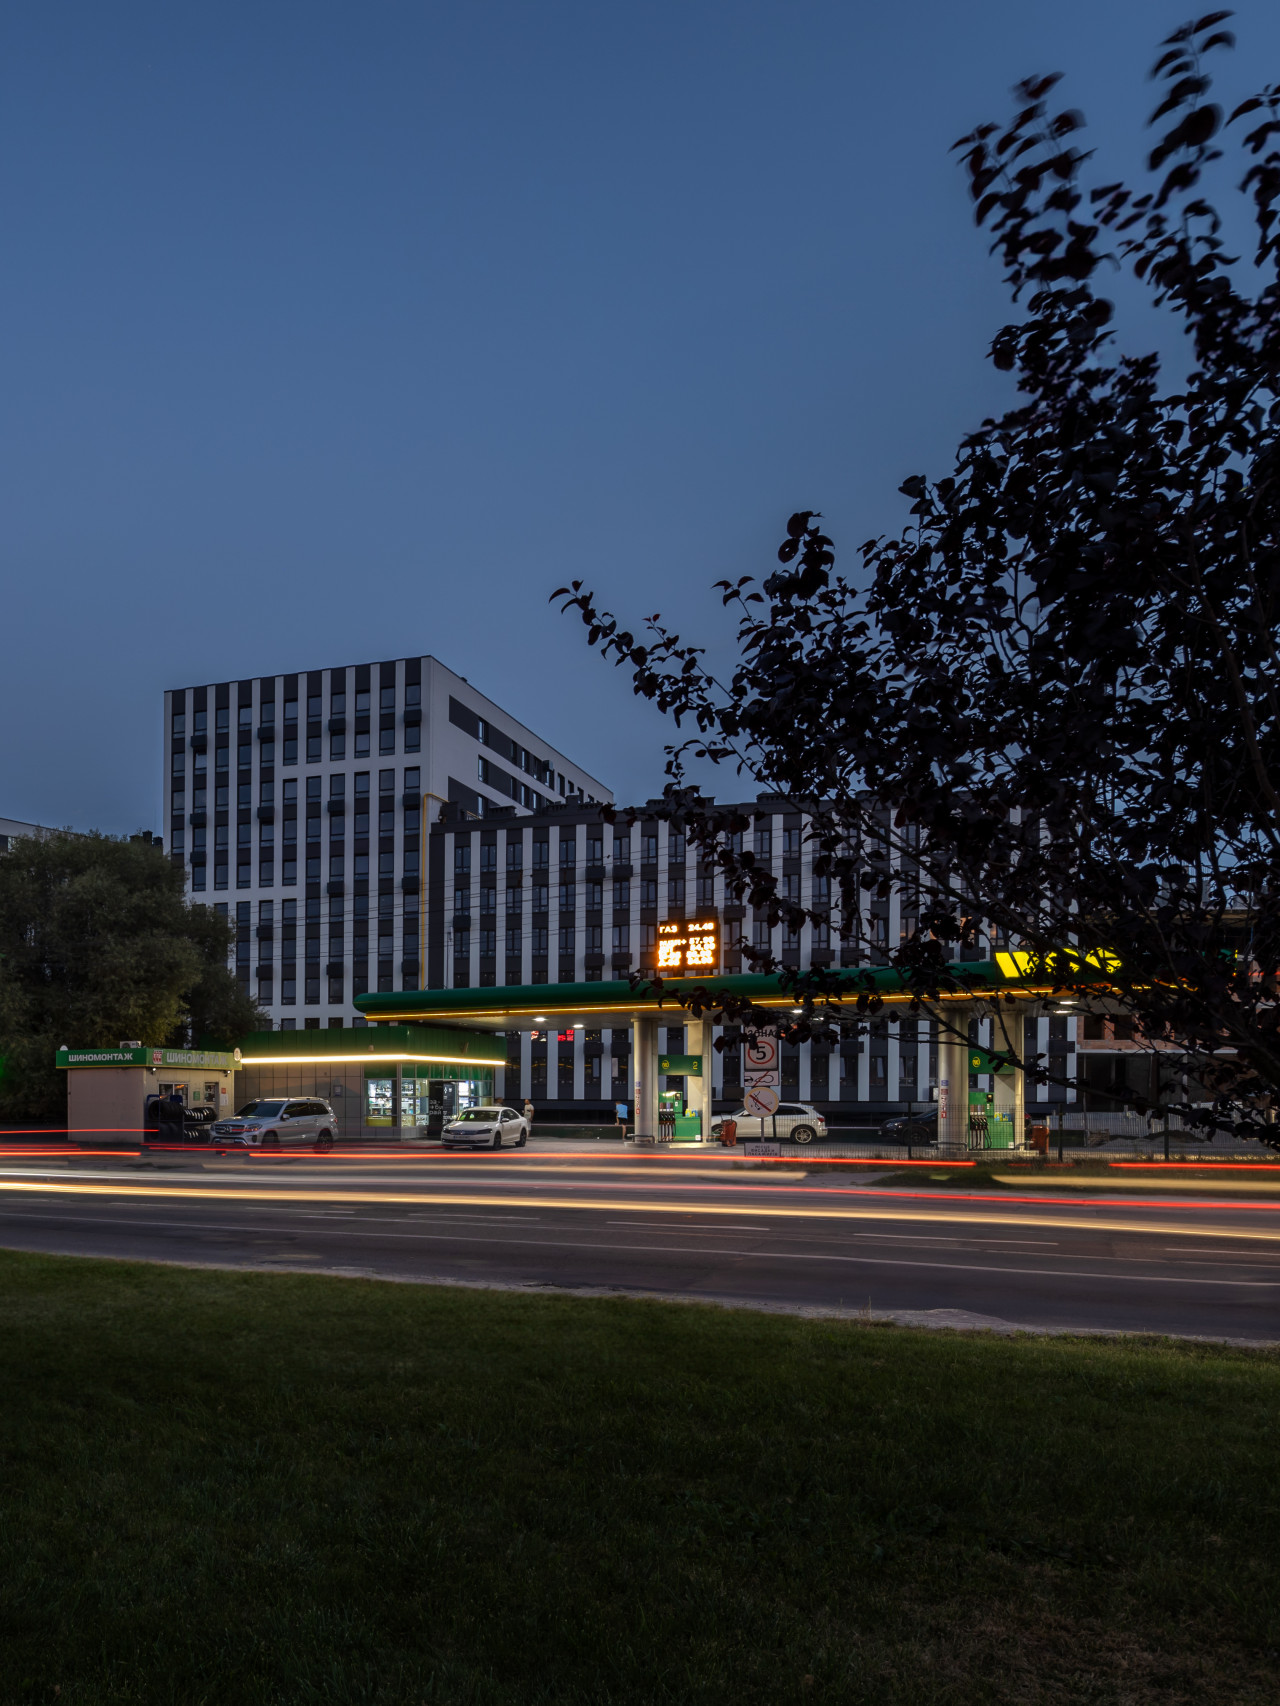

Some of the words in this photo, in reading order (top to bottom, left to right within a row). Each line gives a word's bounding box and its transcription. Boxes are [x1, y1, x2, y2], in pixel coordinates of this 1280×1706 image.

[659, 925, 678, 934] ГАЗ
[68, 1053, 133, 1062] ШИНОМОНТАЖ
[756, 1046, 767, 1060] 5
[166, 1052, 228, 1065] ШИНОМОНТАЖ
[692, 1061, 698, 1070] 2
